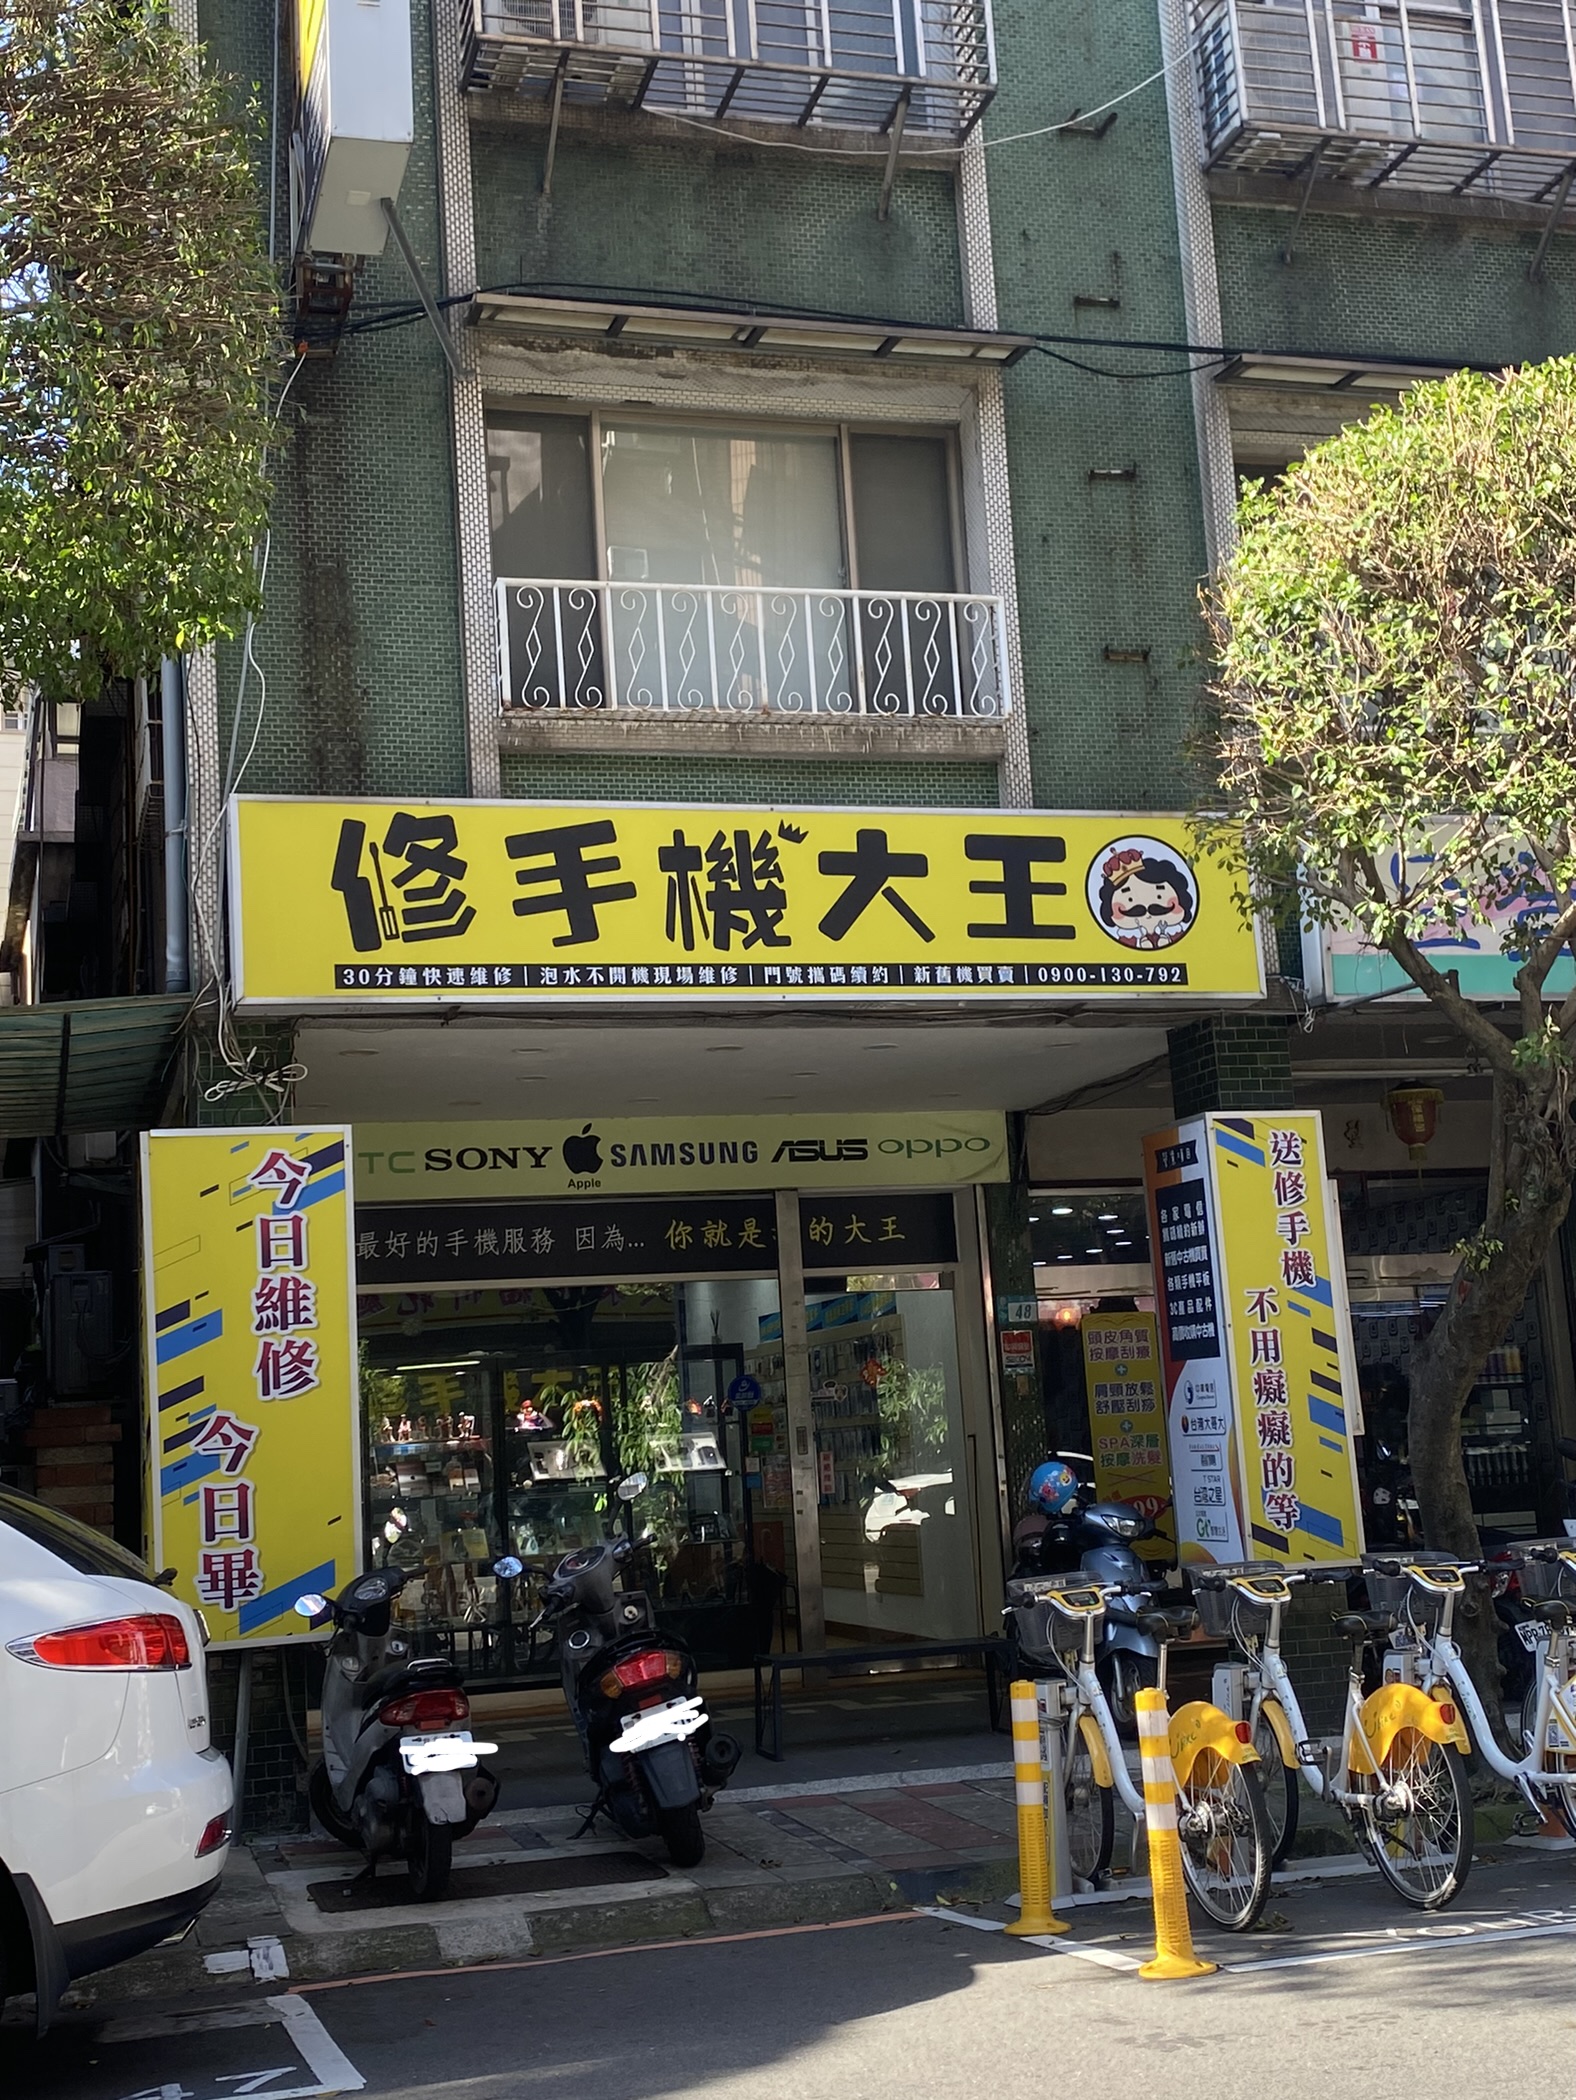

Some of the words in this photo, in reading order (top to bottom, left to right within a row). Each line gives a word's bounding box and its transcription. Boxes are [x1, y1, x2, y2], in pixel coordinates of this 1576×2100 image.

[331, 812, 1077, 952] 修手機大王
[343, 967, 512, 987] 30分鐘快速維修
[540, 966, 738, 985] 泡水不開機現場維修
[914, 965, 1014, 984] 新舊機買賣
[1038, 966, 1182, 983] 0900-130-792
[425, 1146, 552, 1172] SONY
[611, 1141, 758, 1168] SAMSUNG
[771, 1138, 868, 1163] ASUS
[567, 1178, 602, 1189] Apple
[1271, 1132, 1315, 1286] 送修手機
[357, 1227, 556, 1260] 最好的手機服務
[252, 1152, 316, 1397] 今日維修
[1015, 1304, 1032, 1320] 48
[1088, 1329, 1149, 1345] 頭皮角質
[1246, 1287, 1299, 1530] 不用癡癡的等
[195, 1416, 259, 1608] 今日畢
